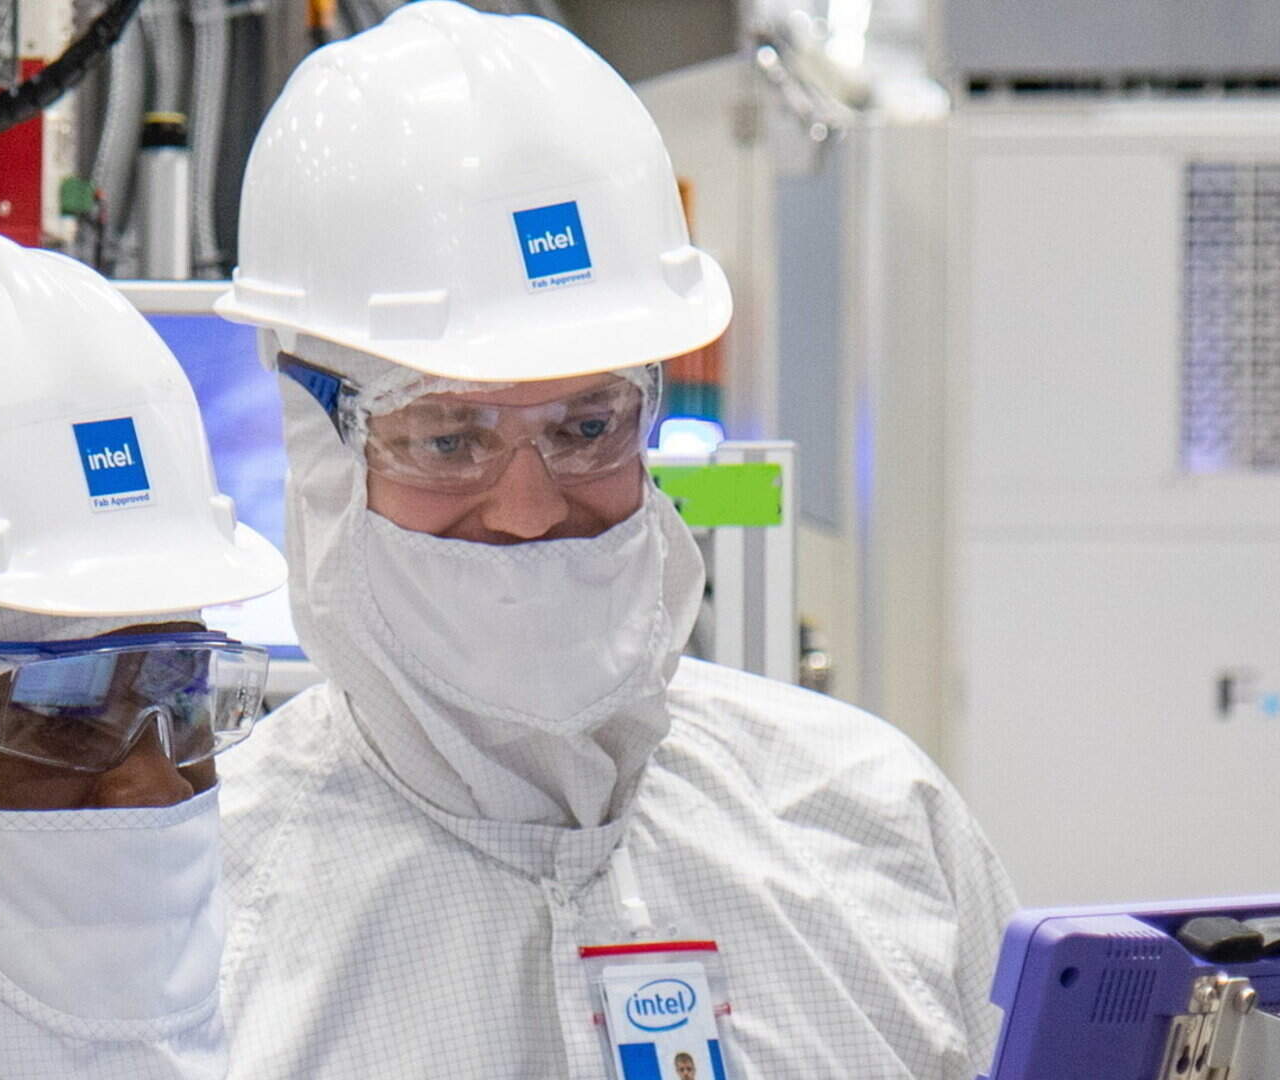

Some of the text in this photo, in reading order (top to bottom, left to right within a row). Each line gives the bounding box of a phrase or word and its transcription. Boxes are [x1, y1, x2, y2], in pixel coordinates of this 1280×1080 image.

[527, 225, 575, 254] intel
[532, 271, 592, 288] Fab Approved
[86, 443, 133, 471] intel
[94, 493, 150, 507] Fab Approved
[633, 990, 686, 1016] intel
